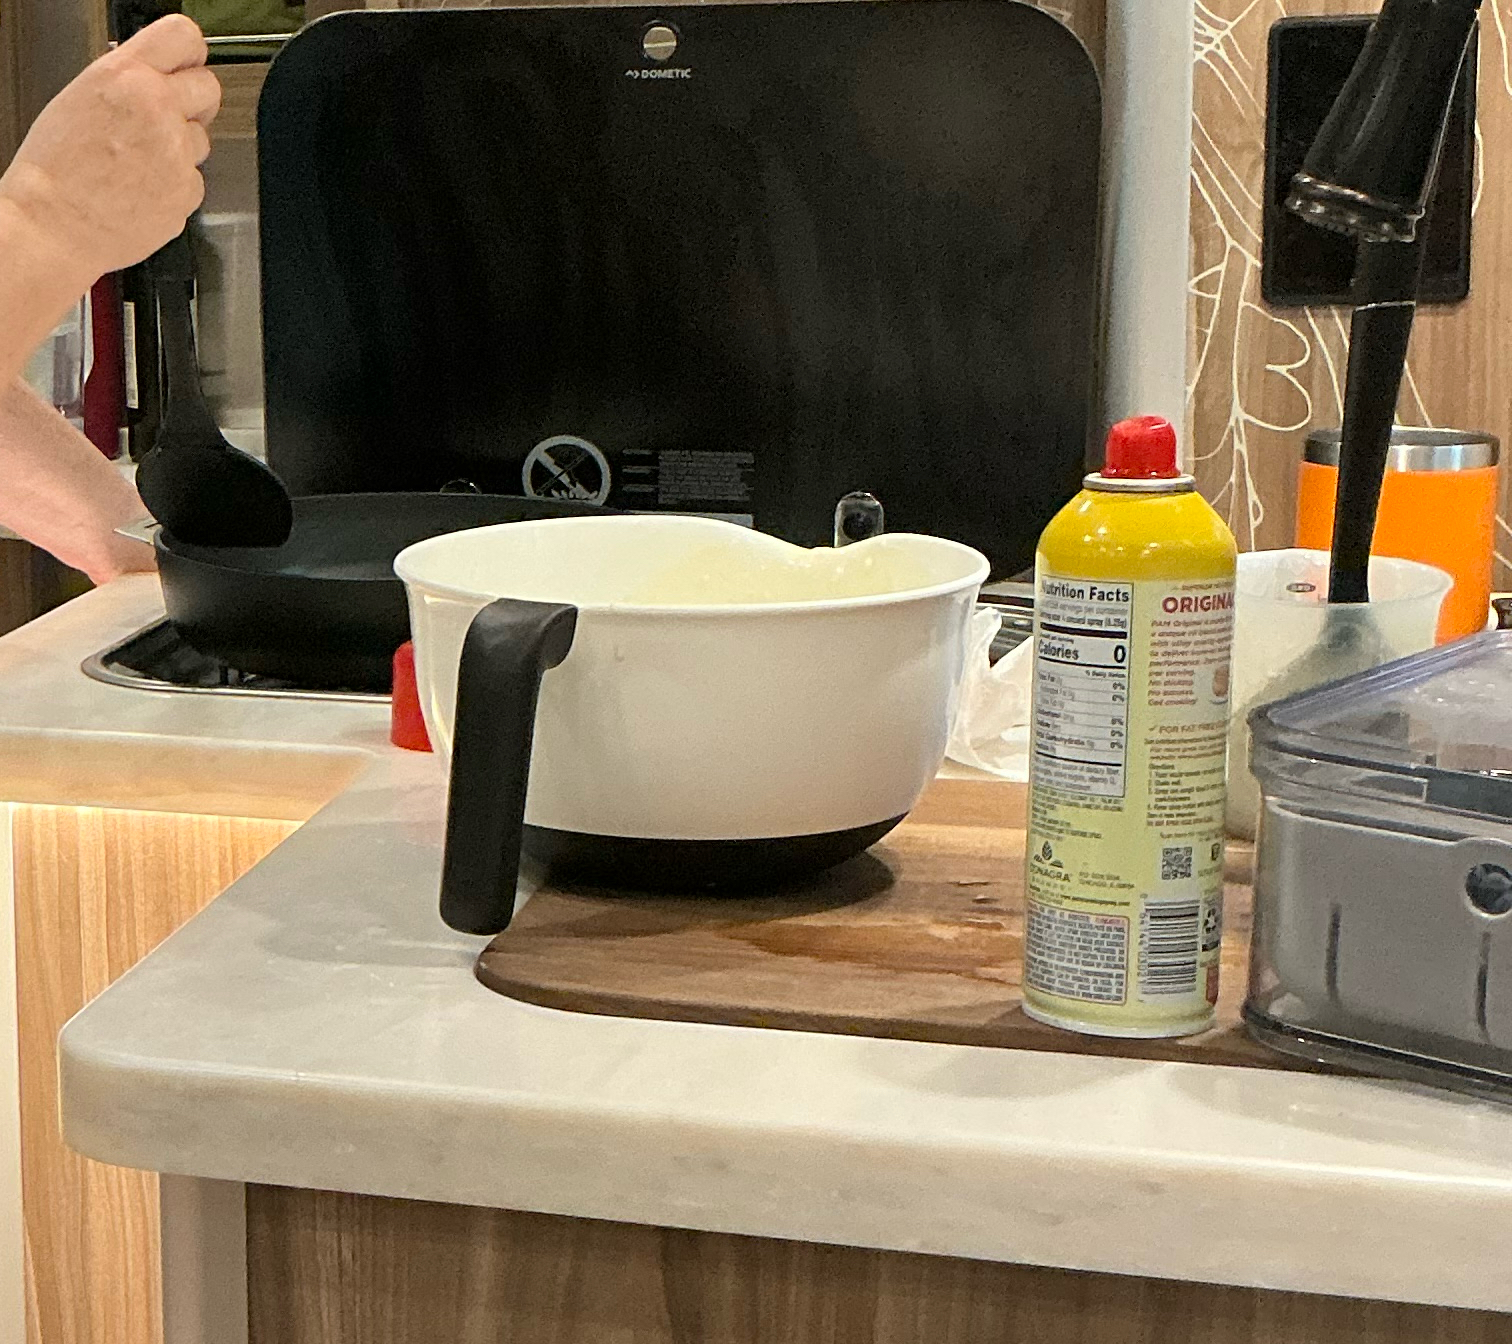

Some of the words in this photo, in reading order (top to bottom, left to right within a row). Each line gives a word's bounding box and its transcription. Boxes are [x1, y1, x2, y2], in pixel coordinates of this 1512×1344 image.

[641, 68, 691, 79] DOMETIC
[1089, 586, 1129, 602] Facts
[1162, 592, 1235, 614] ORIGINA
[1039, 639, 1079, 660] Calories
[1114, 645, 1126, 664] 0
